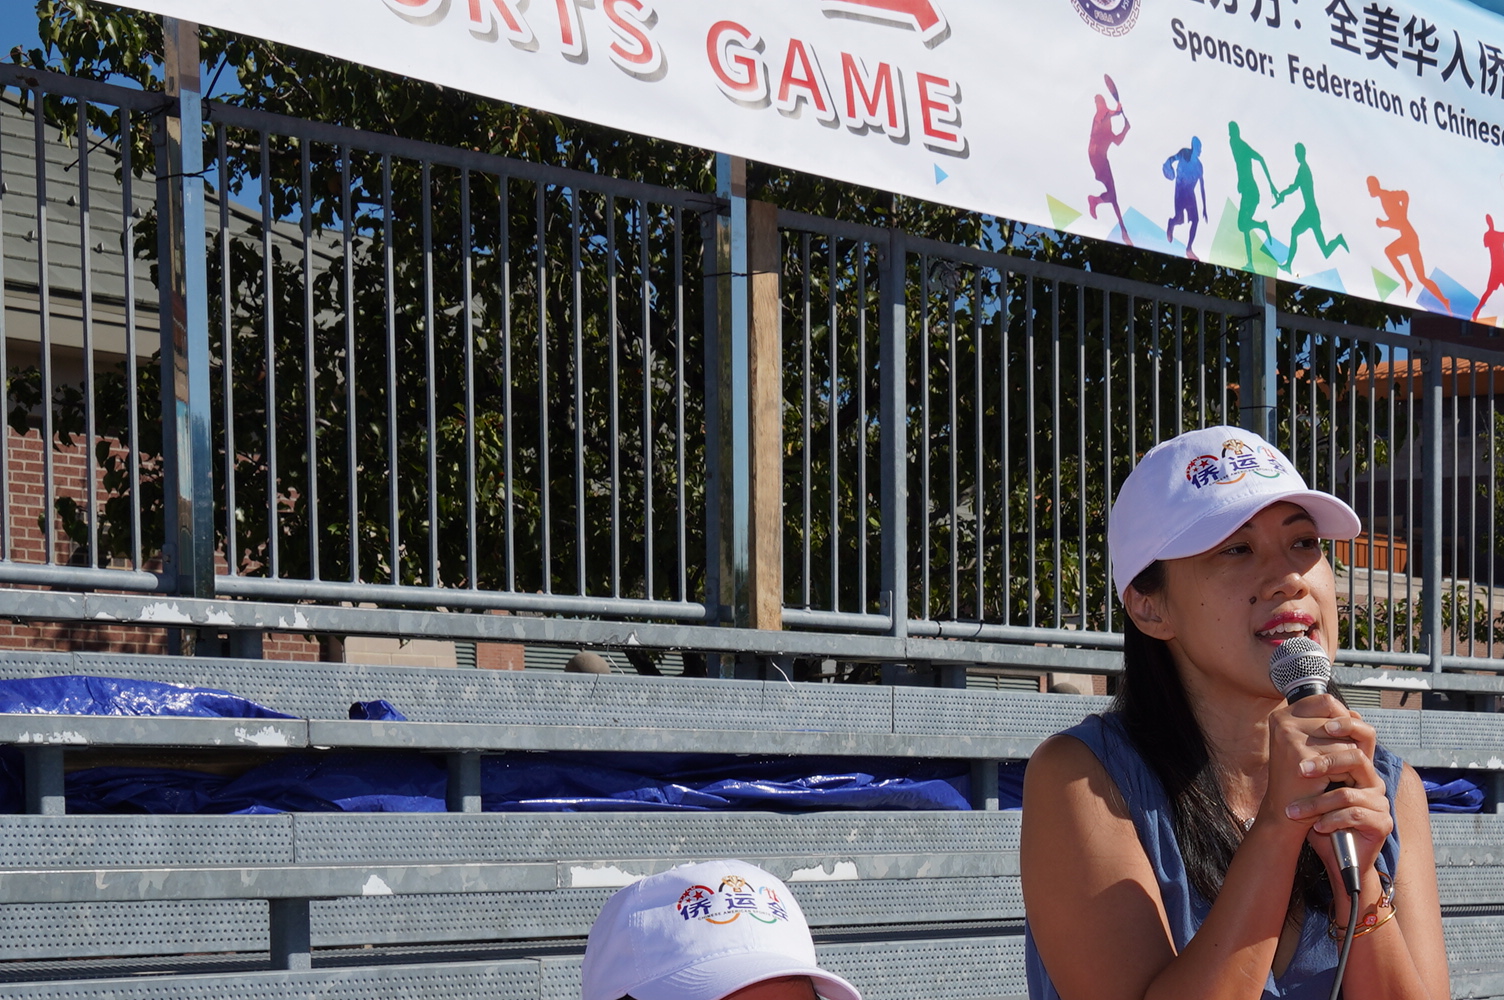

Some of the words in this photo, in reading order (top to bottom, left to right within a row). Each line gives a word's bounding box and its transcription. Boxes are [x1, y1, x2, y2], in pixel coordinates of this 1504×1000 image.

[705, 19, 969, 156] GAME
[1170, 18, 1275, 77] Sponsor:
[1288, 53, 1404, 117] Federation
[1410, 97, 1429, 125] of
[680, 892, 789, 922] 侨运会
